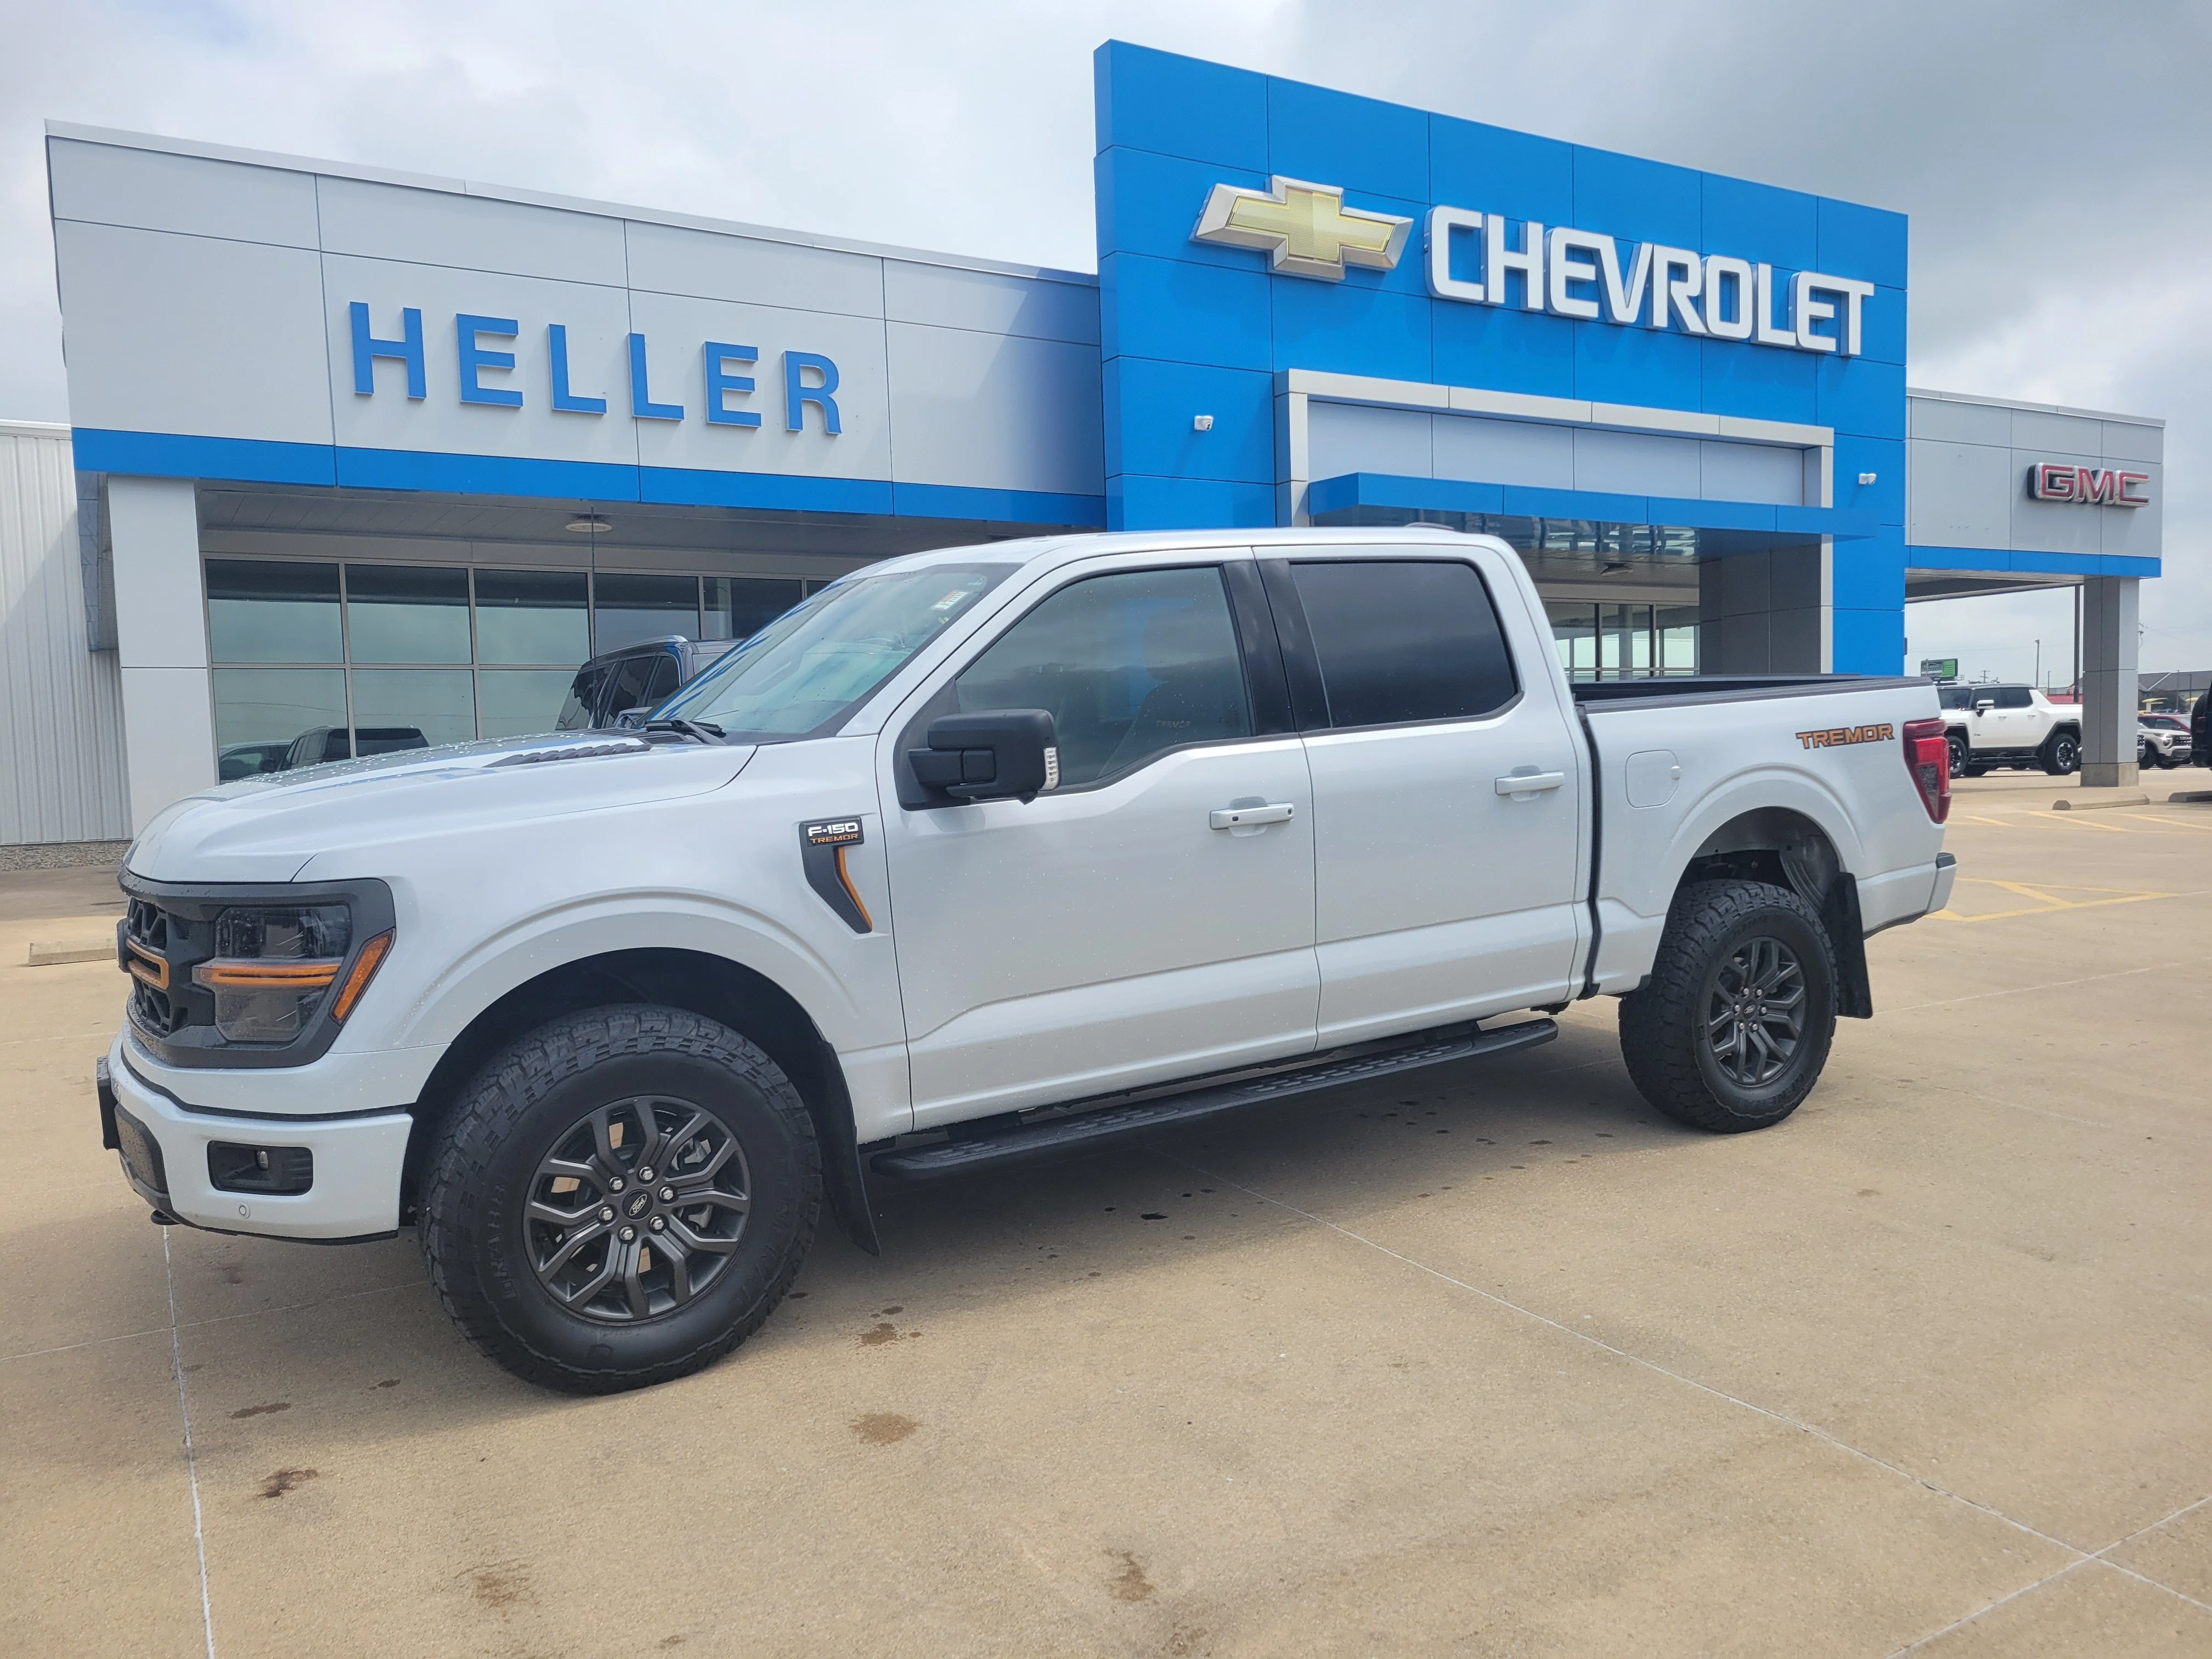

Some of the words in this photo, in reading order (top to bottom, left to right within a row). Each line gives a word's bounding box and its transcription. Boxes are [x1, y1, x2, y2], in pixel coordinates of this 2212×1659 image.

[1425, 205, 1875, 356] CHEVROLET
[349, 301, 842, 435] HELLER
[2028, 462, 2151, 507] GMC
[1795, 723, 1895, 749] TREMOR
[808, 822, 859, 837] F-150
[810, 833, 859, 844] TREMOR
[631, 1197, 646, 1214] Ford
